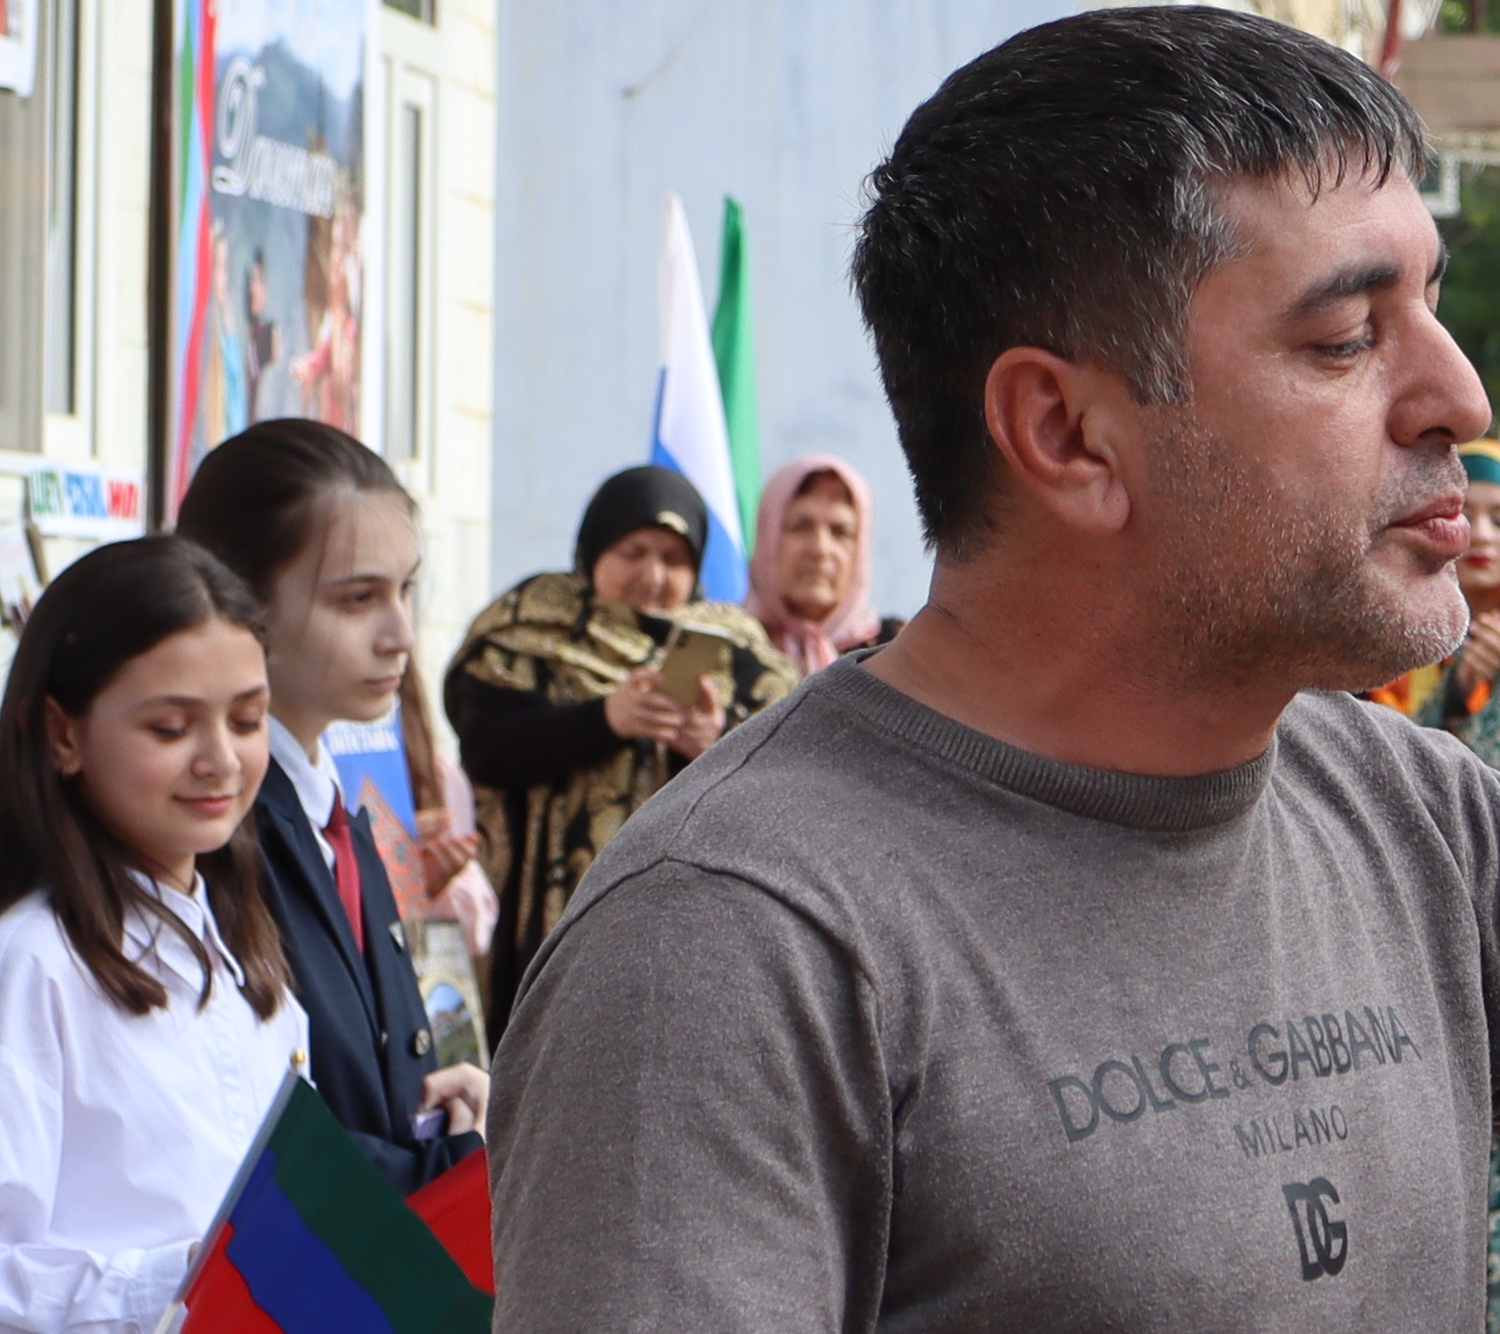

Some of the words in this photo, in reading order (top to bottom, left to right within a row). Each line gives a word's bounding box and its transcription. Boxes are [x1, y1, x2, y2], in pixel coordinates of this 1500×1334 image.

[1048, 1038, 1230, 1142] DOLCE
[1230, 1059, 1246, 1089] &
[1247, 1005, 1421, 1086] GABBANA
[1234, 1104, 1348, 1158] MILANO
